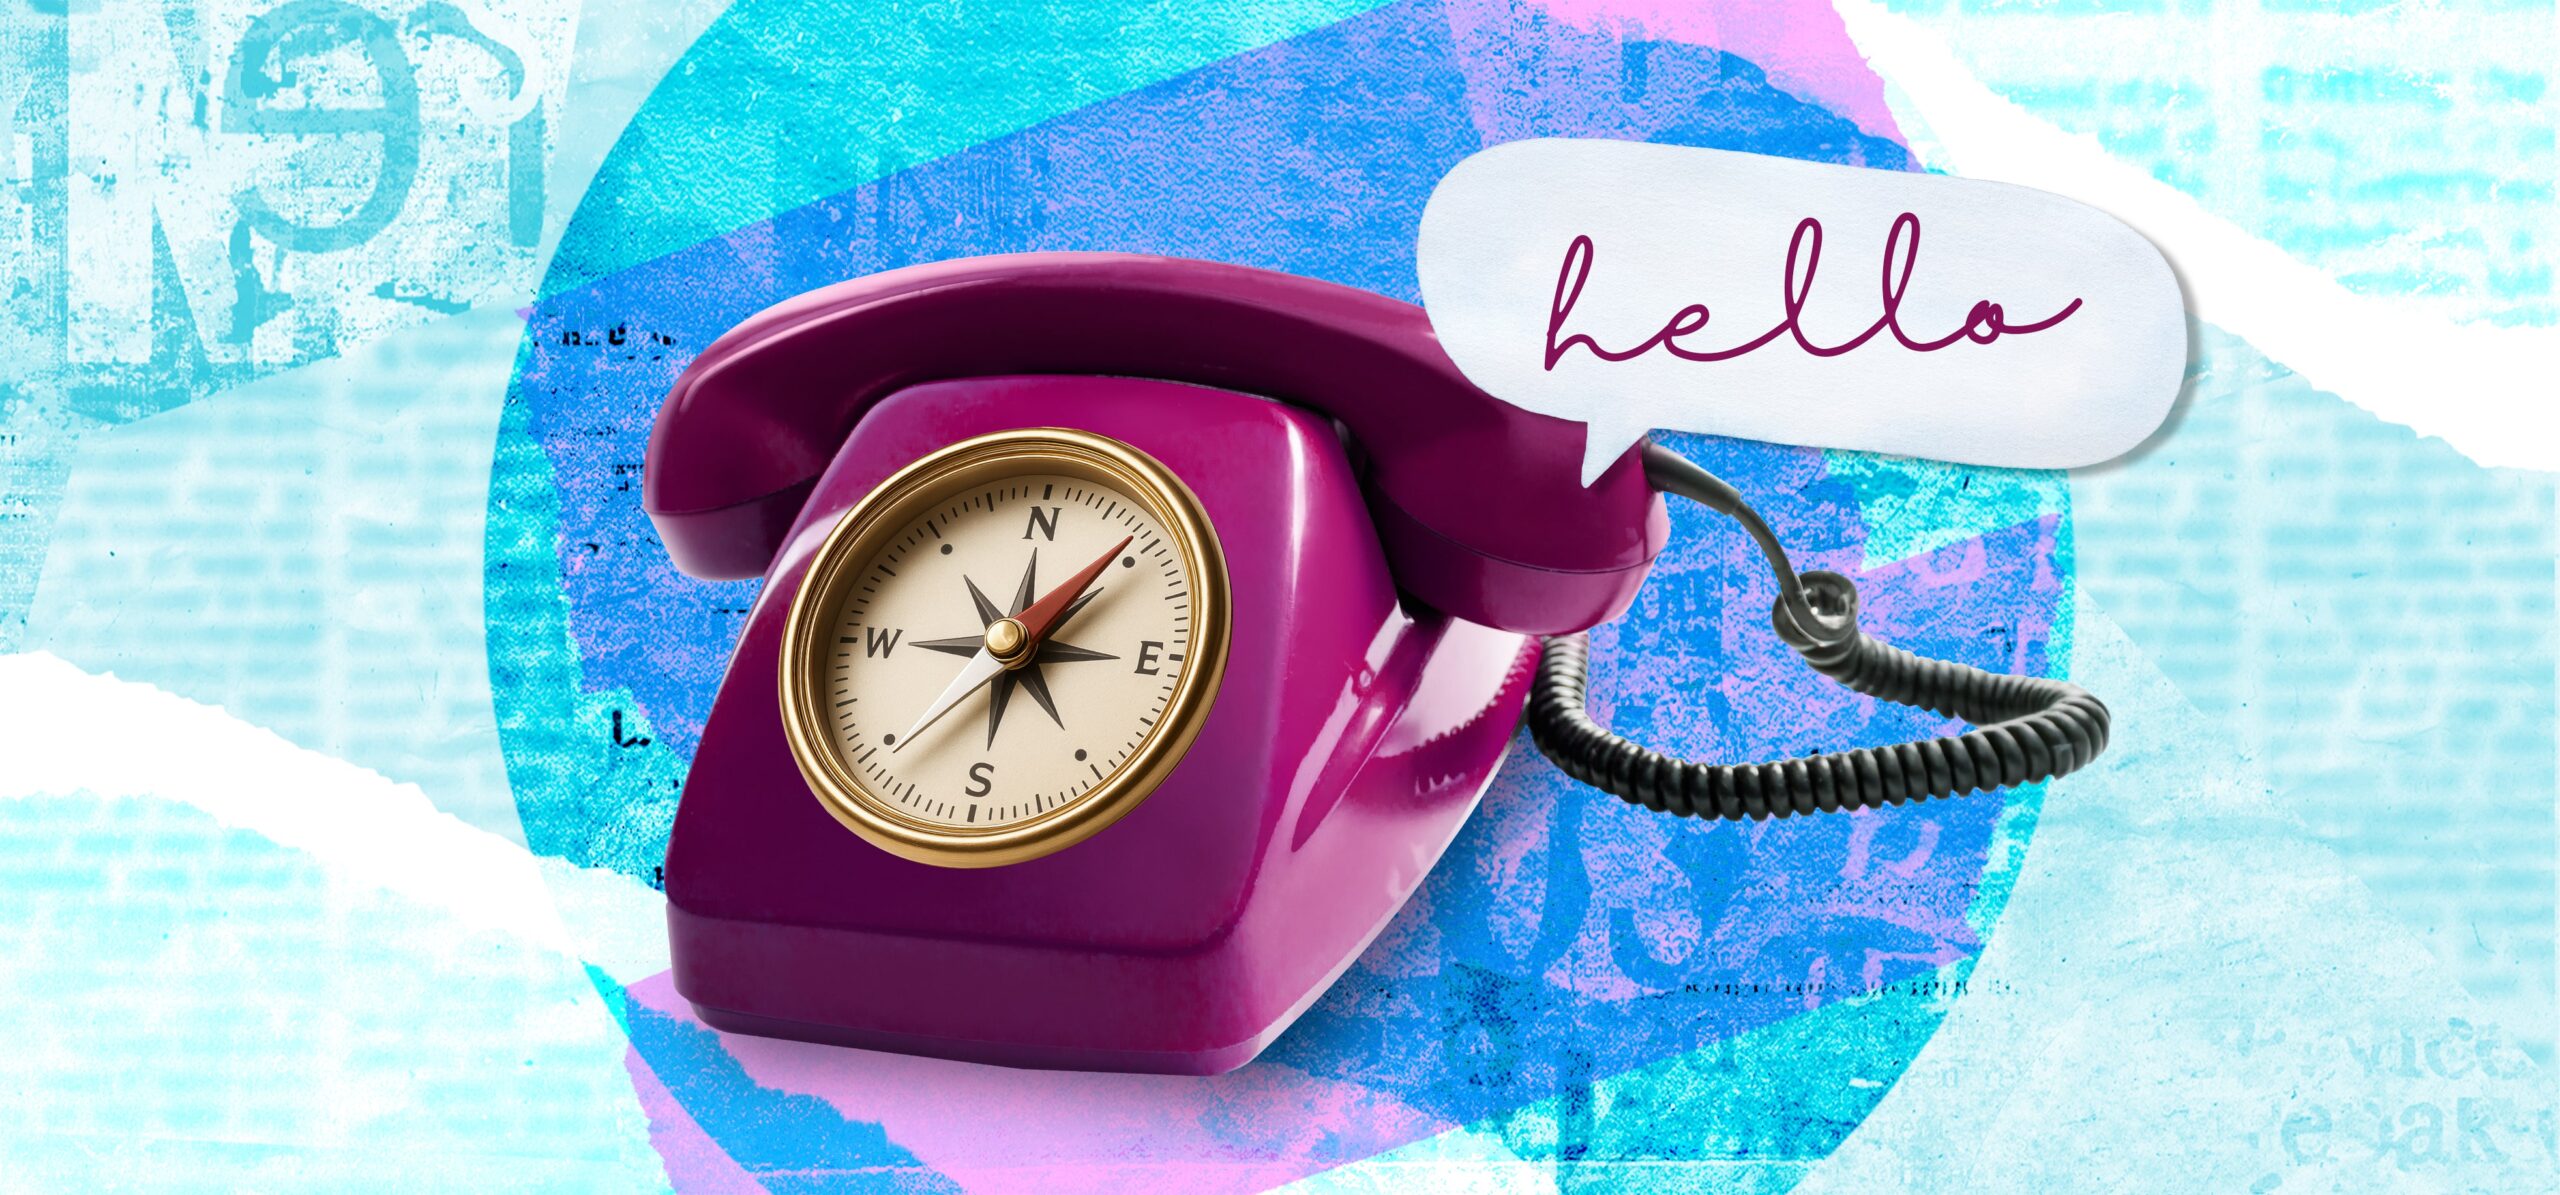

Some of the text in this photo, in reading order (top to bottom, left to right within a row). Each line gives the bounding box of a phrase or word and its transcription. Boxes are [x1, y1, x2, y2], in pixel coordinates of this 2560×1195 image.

[1545, 213, 2082, 371] hello
[1022, 505, 1063, 542] N
[866, 626, 904, 660] W
[1133, 640, 1164, 677] E
[965, 762, 995, 798] S
